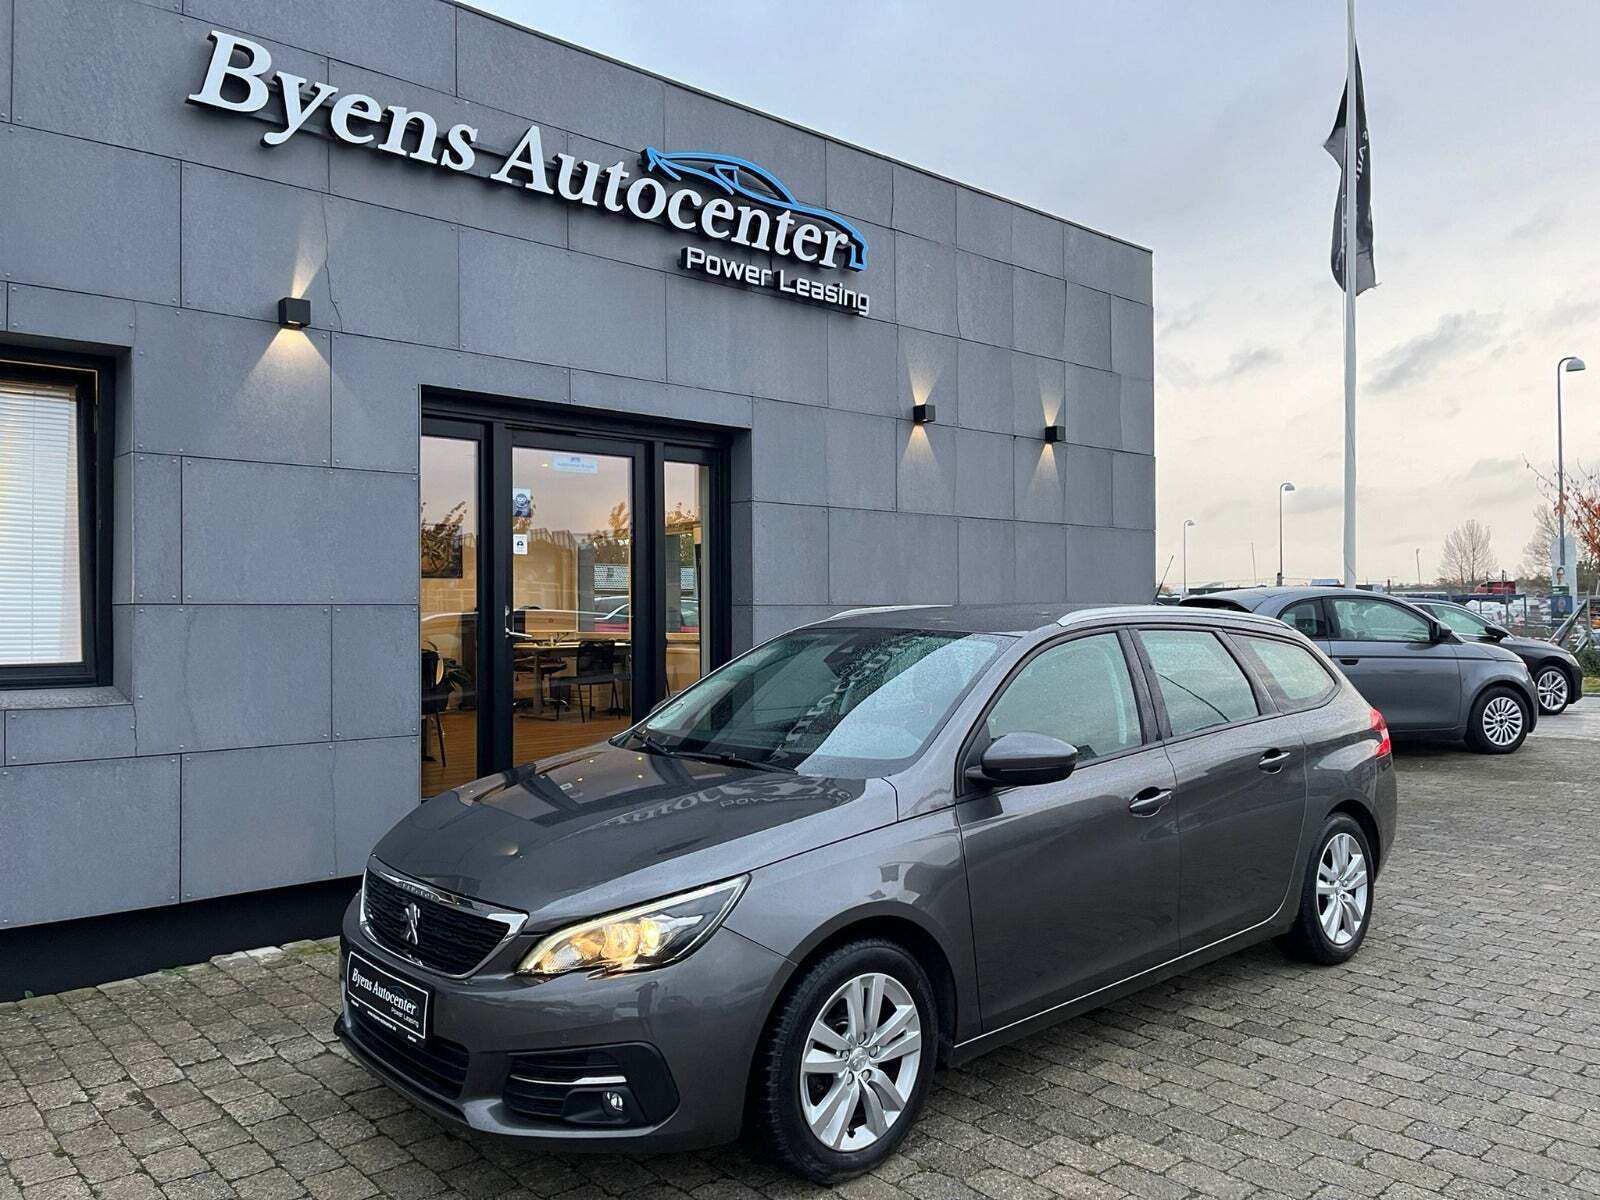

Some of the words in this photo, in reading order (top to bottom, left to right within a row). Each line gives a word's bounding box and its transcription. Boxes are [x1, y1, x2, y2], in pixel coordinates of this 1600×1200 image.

[187, 30, 479, 171] Byens
[490, 125, 849, 268] Autocenter
[686, 246, 773, 287] Power
[779, 270, 870, 316] Leasing
[352, 968, 373, 991] Byens
[372, 980, 417, 1015] Autocenter
